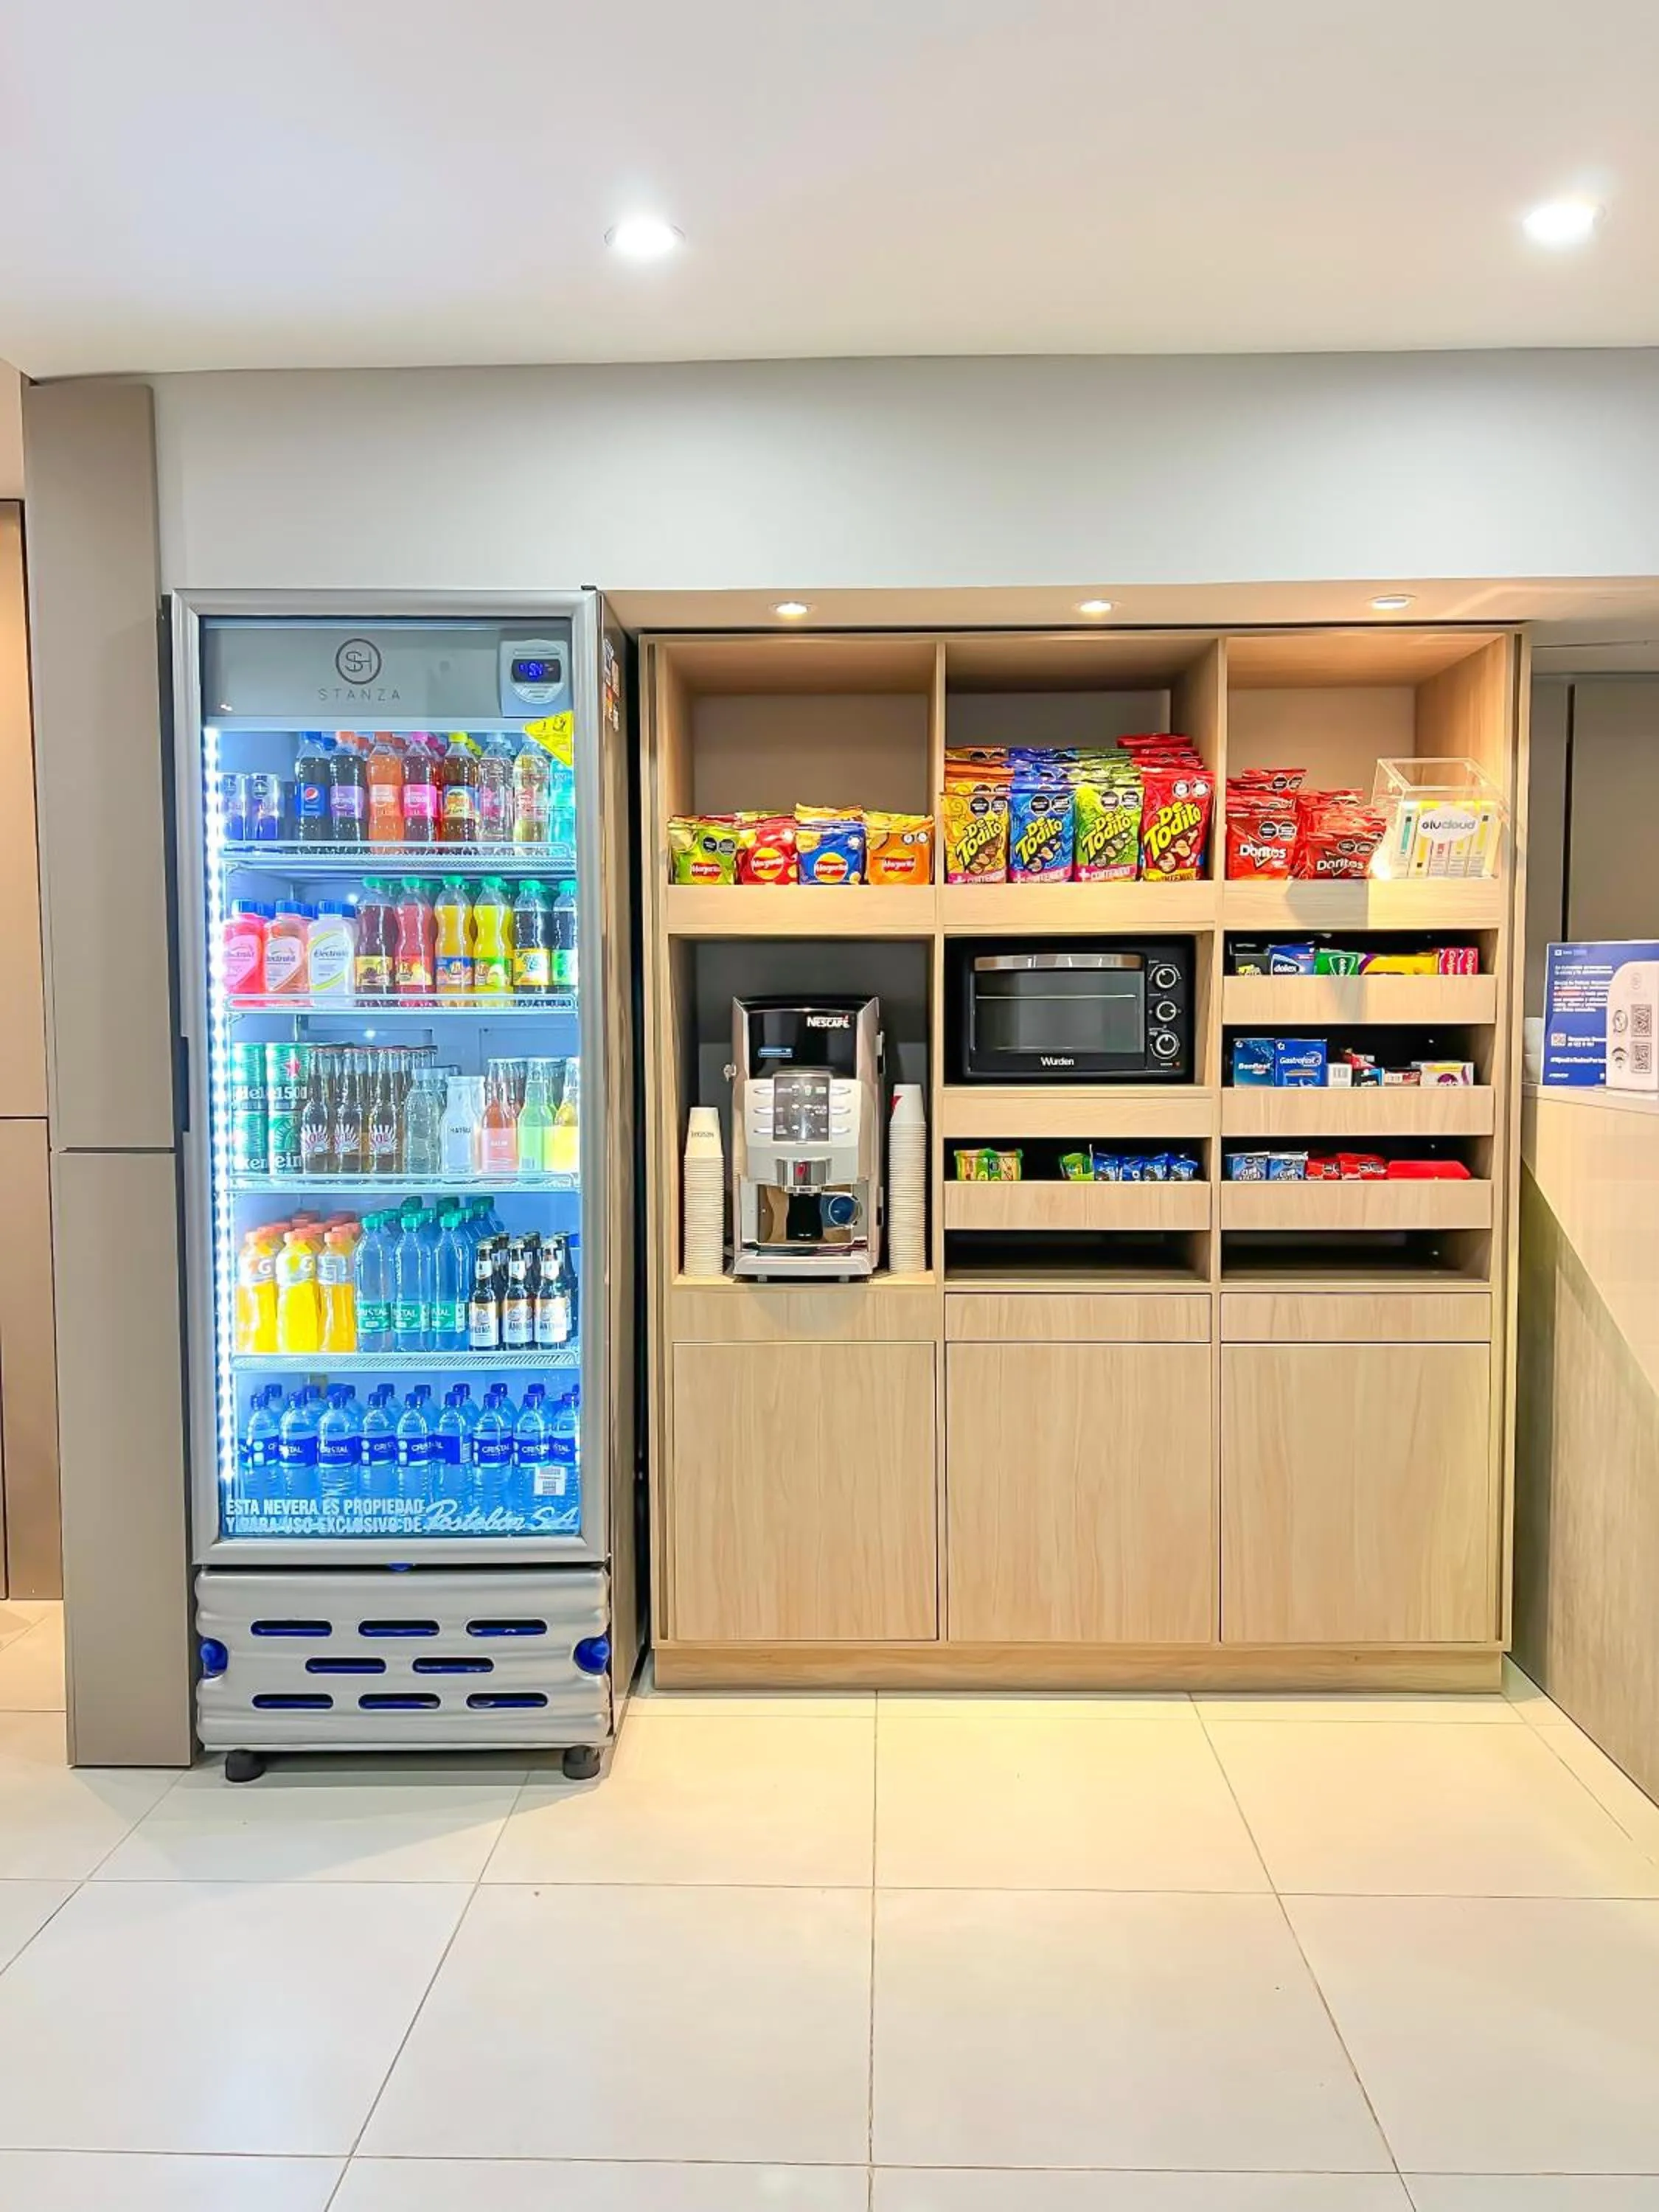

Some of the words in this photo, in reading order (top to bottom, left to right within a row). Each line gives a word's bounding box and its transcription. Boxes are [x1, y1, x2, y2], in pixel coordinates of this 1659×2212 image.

[318, 688, 400, 701] STANZA
[1082, 814, 1133, 860] Todito
[1144, 803, 1202, 862] Todito
[956, 820, 1003, 867] Todito
[1015, 818, 1062, 866] Todito
[1239, 844, 1287, 859] Doritos
[1316, 857, 1364, 872] Doritos
[1273, 964, 1296, 973] dolex
[806, 1015, 850, 1029] NESCAFÉ
[1040, 1056, 1074, 1066] Wurden
[226, 1498, 260, 1515] ESTA
[263, 1498, 320, 1515] NEVERA
[323, 1498, 340, 1515] ES
[344, 1498, 425, 1516] PROPIEDAD
[226, 1517, 236, 1533] Y
[238, 1517, 279, 1533] PARA
[285, 1517, 315, 1534] USO
[317, 1517, 400, 1534] EXCLUSIVO
[404, 1517, 422, 1534] DE
